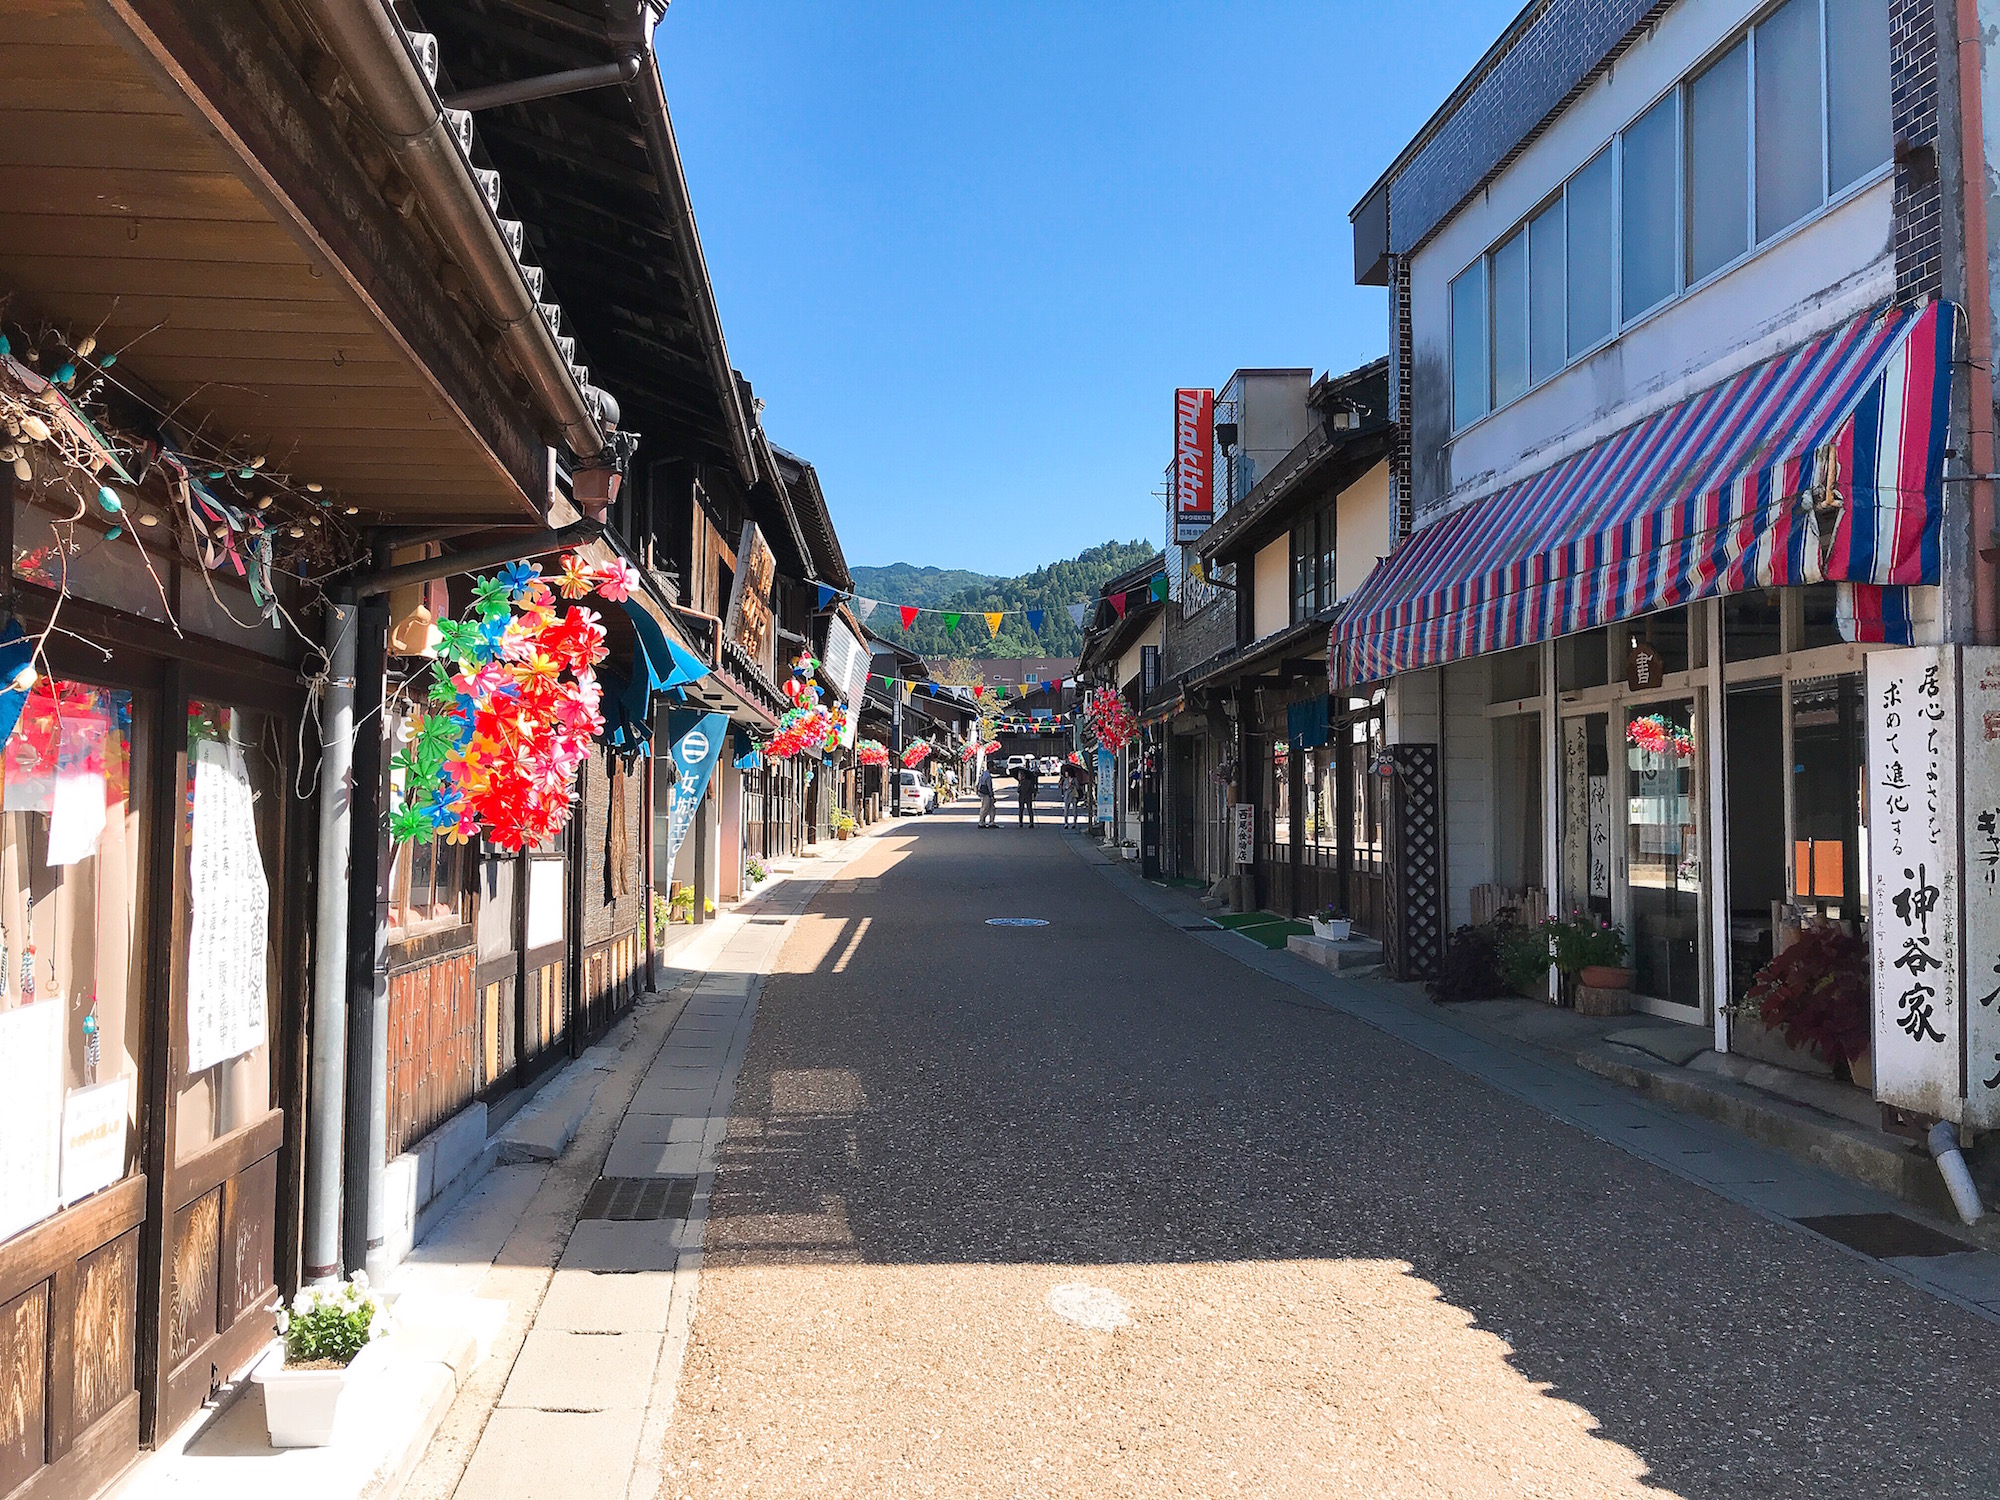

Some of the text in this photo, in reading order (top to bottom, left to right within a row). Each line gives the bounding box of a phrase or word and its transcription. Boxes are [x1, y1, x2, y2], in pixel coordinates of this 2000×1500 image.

[1636, 651, 1653, 684] 書
[1882, 678, 1911, 856] 求めて進化する
[1892, 863, 1946, 1043] 神谷家
